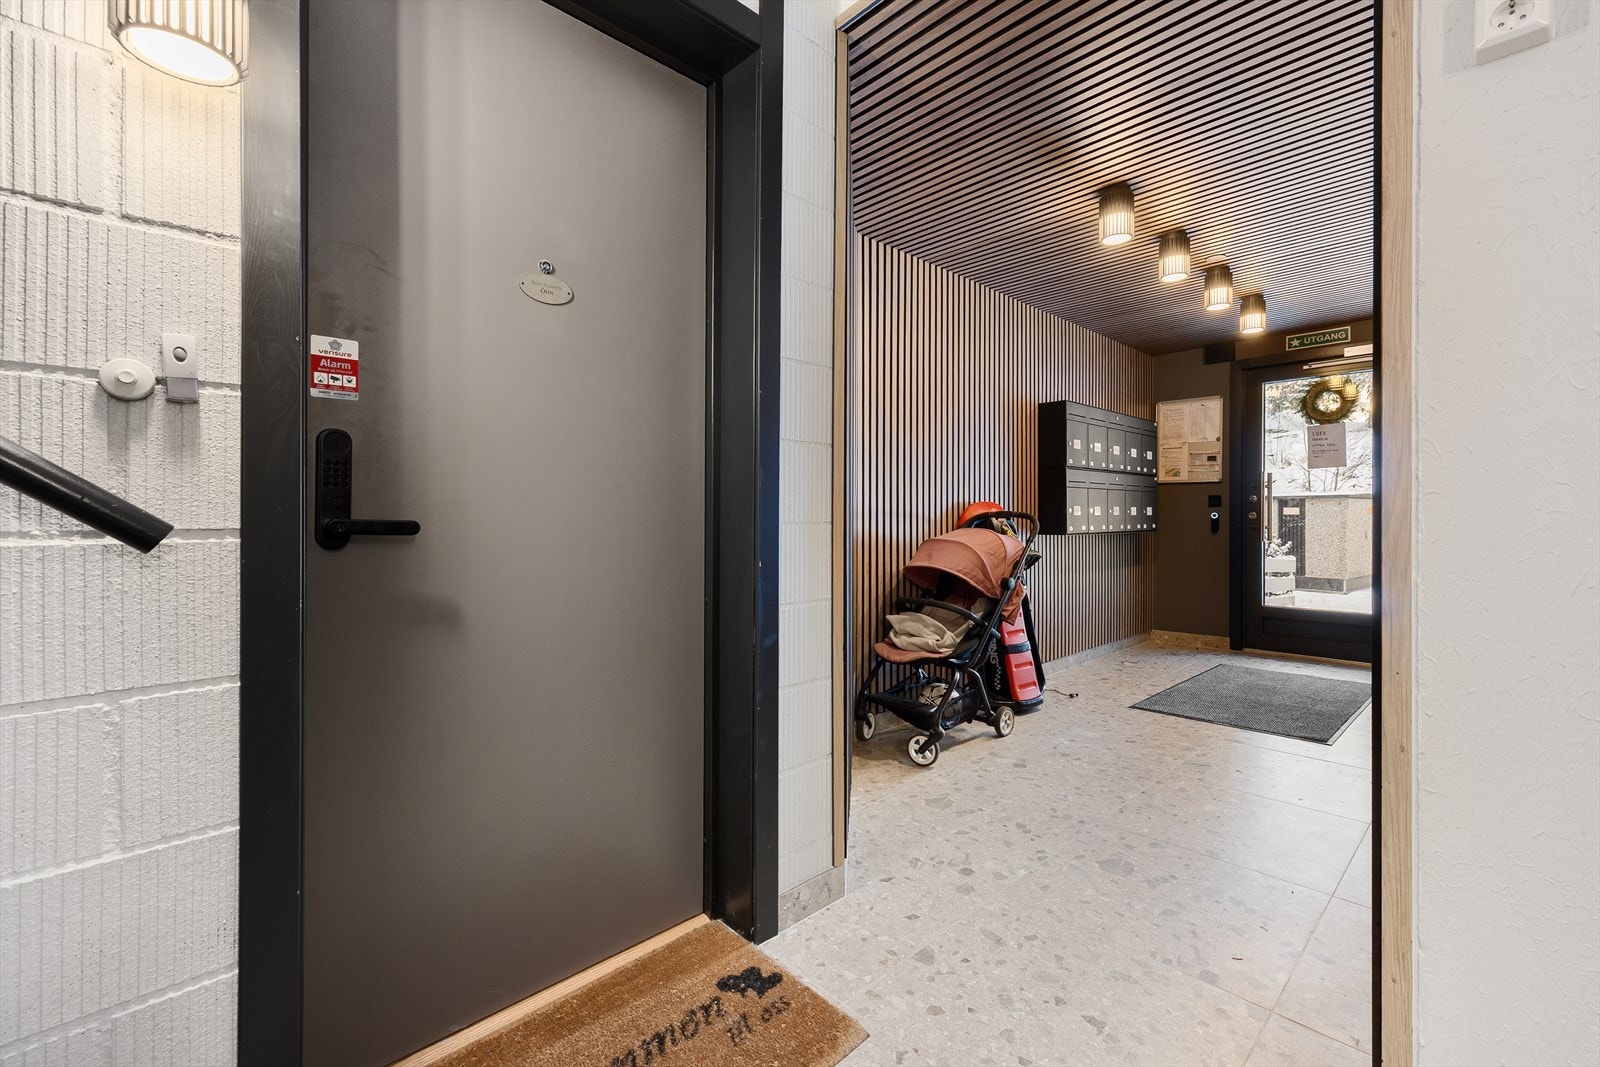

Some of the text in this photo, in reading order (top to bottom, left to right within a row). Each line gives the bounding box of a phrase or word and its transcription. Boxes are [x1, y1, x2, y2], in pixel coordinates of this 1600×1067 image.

[1303, 331, 1346, 344] UTGANG
[318, 349, 352, 358] verisure
[320, 359, 351, 370] Alarm
